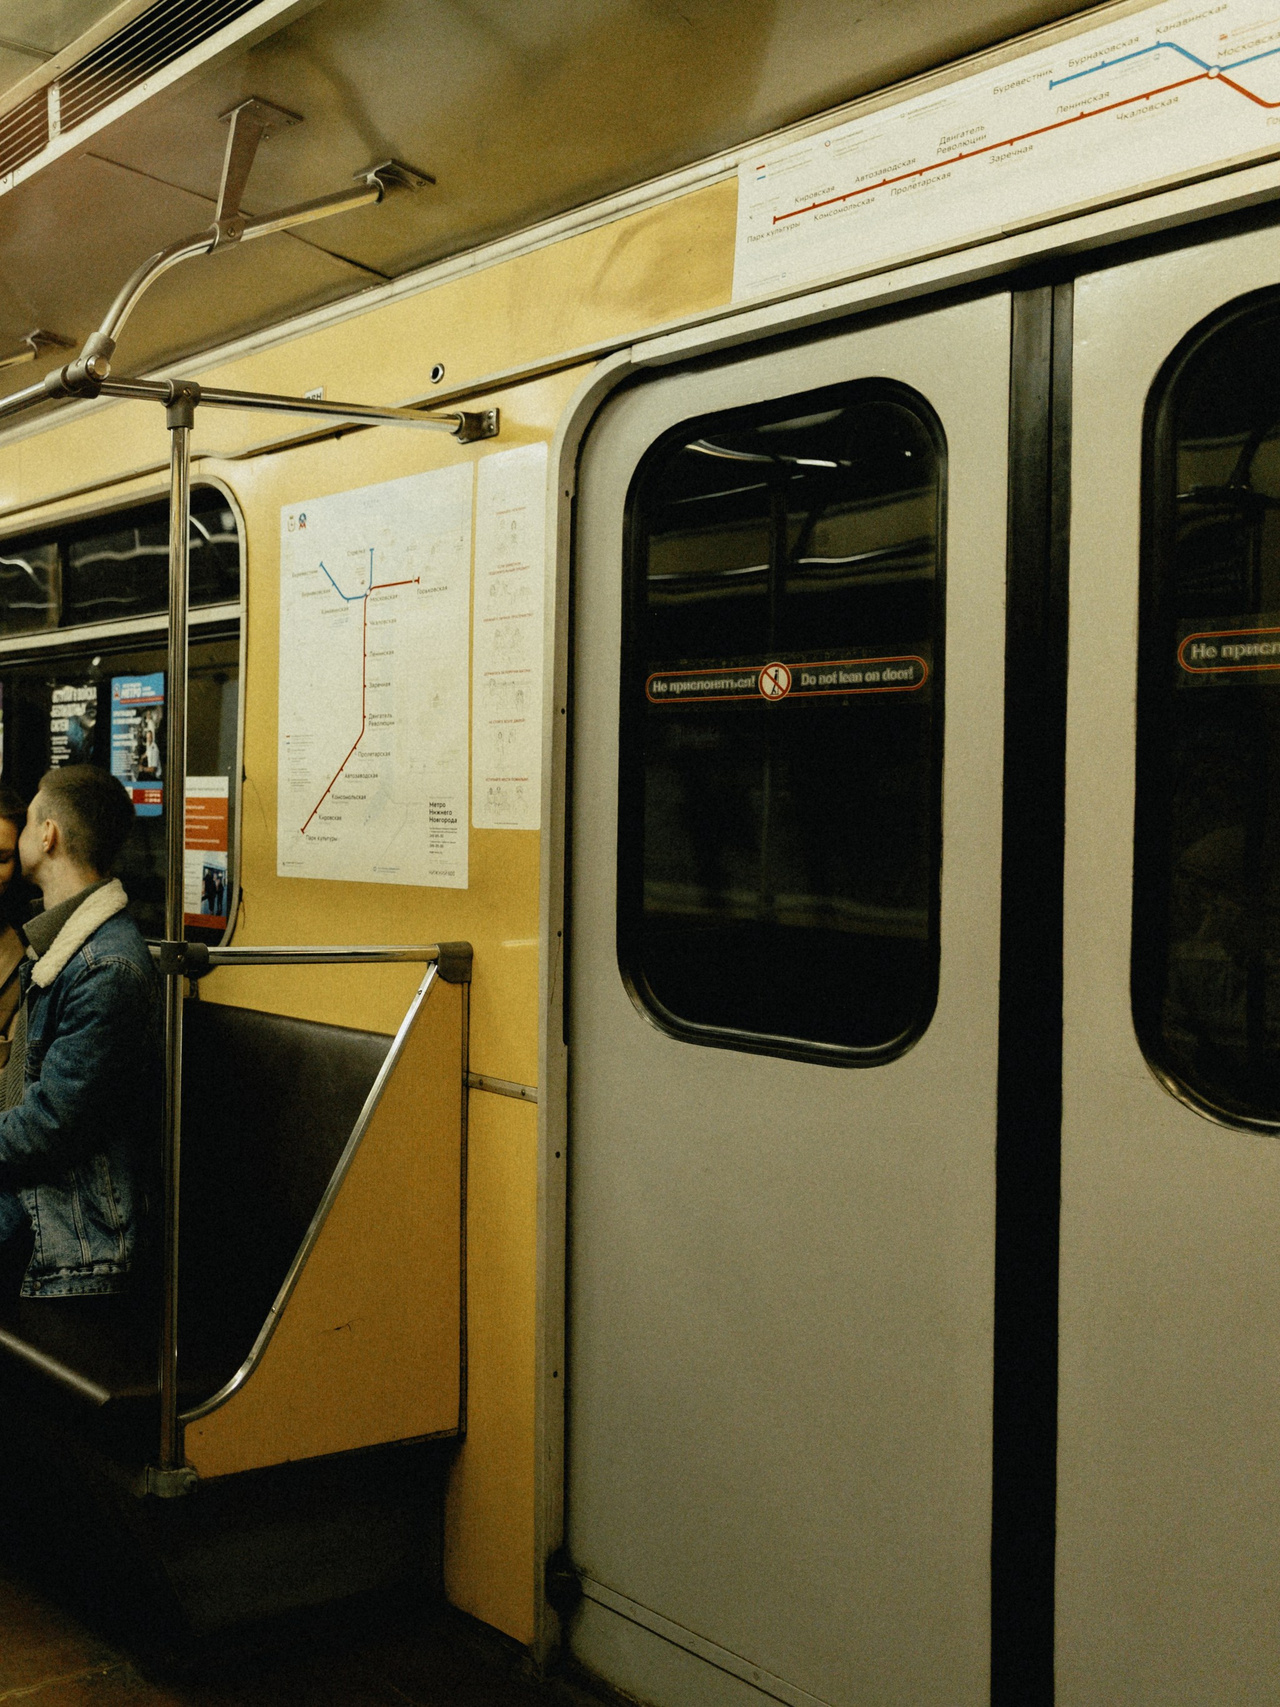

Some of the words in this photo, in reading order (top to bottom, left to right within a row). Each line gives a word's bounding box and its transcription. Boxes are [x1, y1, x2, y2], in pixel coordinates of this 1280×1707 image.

[1155, 4, 1228, 35] Канавинская
[1067, 37, 1140, 68] Бурнаковская
[993, 69, 1053, 95] Буревестник
[1055, 91, 1110, 115] Ленинская
[1116, 97, 1179, 121] Чкаловская
[937, 134, 987, 155] Революции
[939, 125, 985, 146] Двигатель
[989, 145, 1034, 164] Заречная
[854, 158, 916, 183] Автозаводская
[890, 172, 951, 196] Пролетарская
[794, 186, 836, 204] Кировская
[813, 197, 875, 221] Комсомольская
[746, 233, 764, 243] Парк
[766, 222, 801, 237] культуры
[1190, 643, 1217, 660] Не
[652, 680, 668, 693] Не
[669, 675, 756, 694] прислоняться!
[801, 673, 818, 686] Do
[819, 671, 838, 685] not
[839, 670, 863, 684] lean
[865, 671, 880, 682] on
[882, 665, 914, 680] door!
[428, 801, 446, 809] Метро
[428, 816, 458, 824] Новгорода
